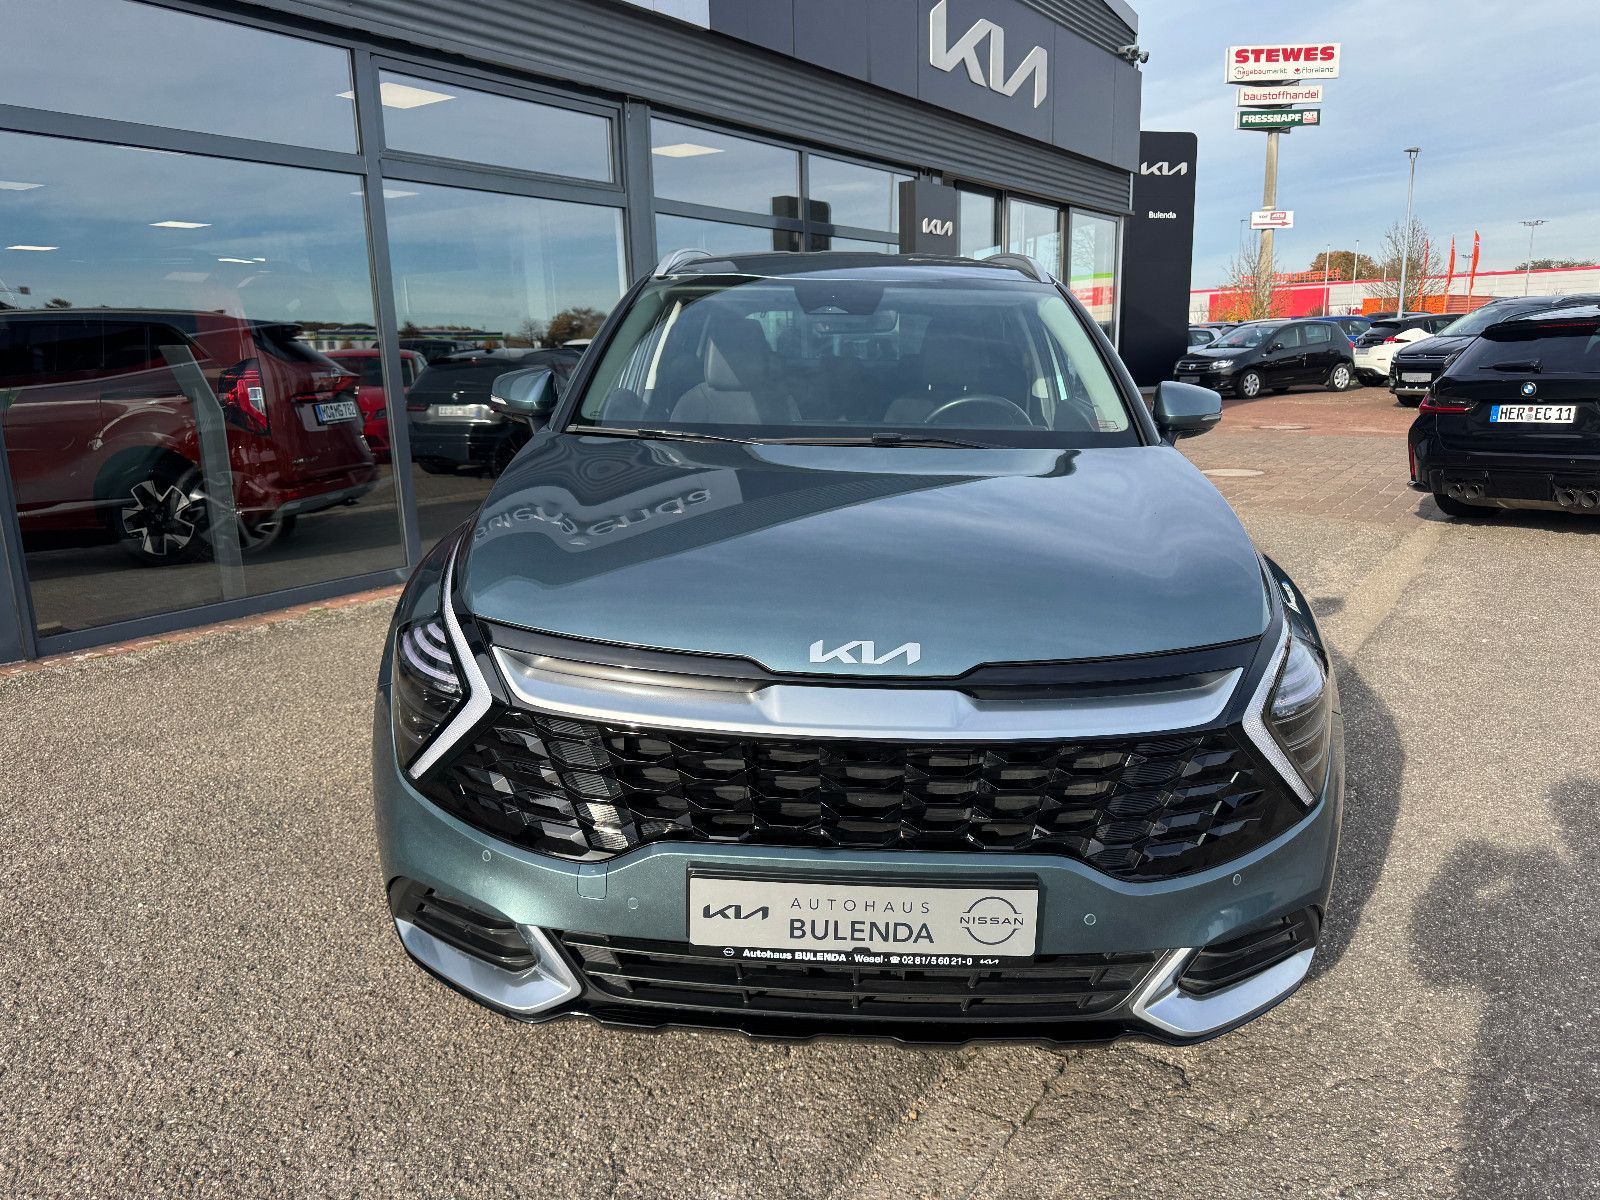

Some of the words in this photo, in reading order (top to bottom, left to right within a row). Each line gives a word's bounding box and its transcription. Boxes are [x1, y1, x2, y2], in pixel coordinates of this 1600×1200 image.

[929, 0, 1048, 109] KIA
[1235, 46, 1335, 64] STEWES
[1243, 90, 1319, 101] baustoffhandel
[1242, 113, 1302, 124] FRESSNAPF
[1140, 161, 1188, 176] KIA
[1148, 210, 1177, 219] Bulenda
[921, 217, 953, 237] KIA
[1499, 407, 1526, 420] HER
[1534, 407, 1553, 420] EC
[1554, 408, 1572, 421] 11
[809, 639, 921, 666] KIA
[702, 903, 769, 921] KIA
[790, 897, 930, 914] AUTOHAUS
[960, 915, 1024, 926] NISSAN
[789, 918, 935, 944] BULENDA
[742, 948, 792, 960] Autohaus
[794, 951, 847, 963] BULENDA
[854, 953, 884, 964] Wesel
